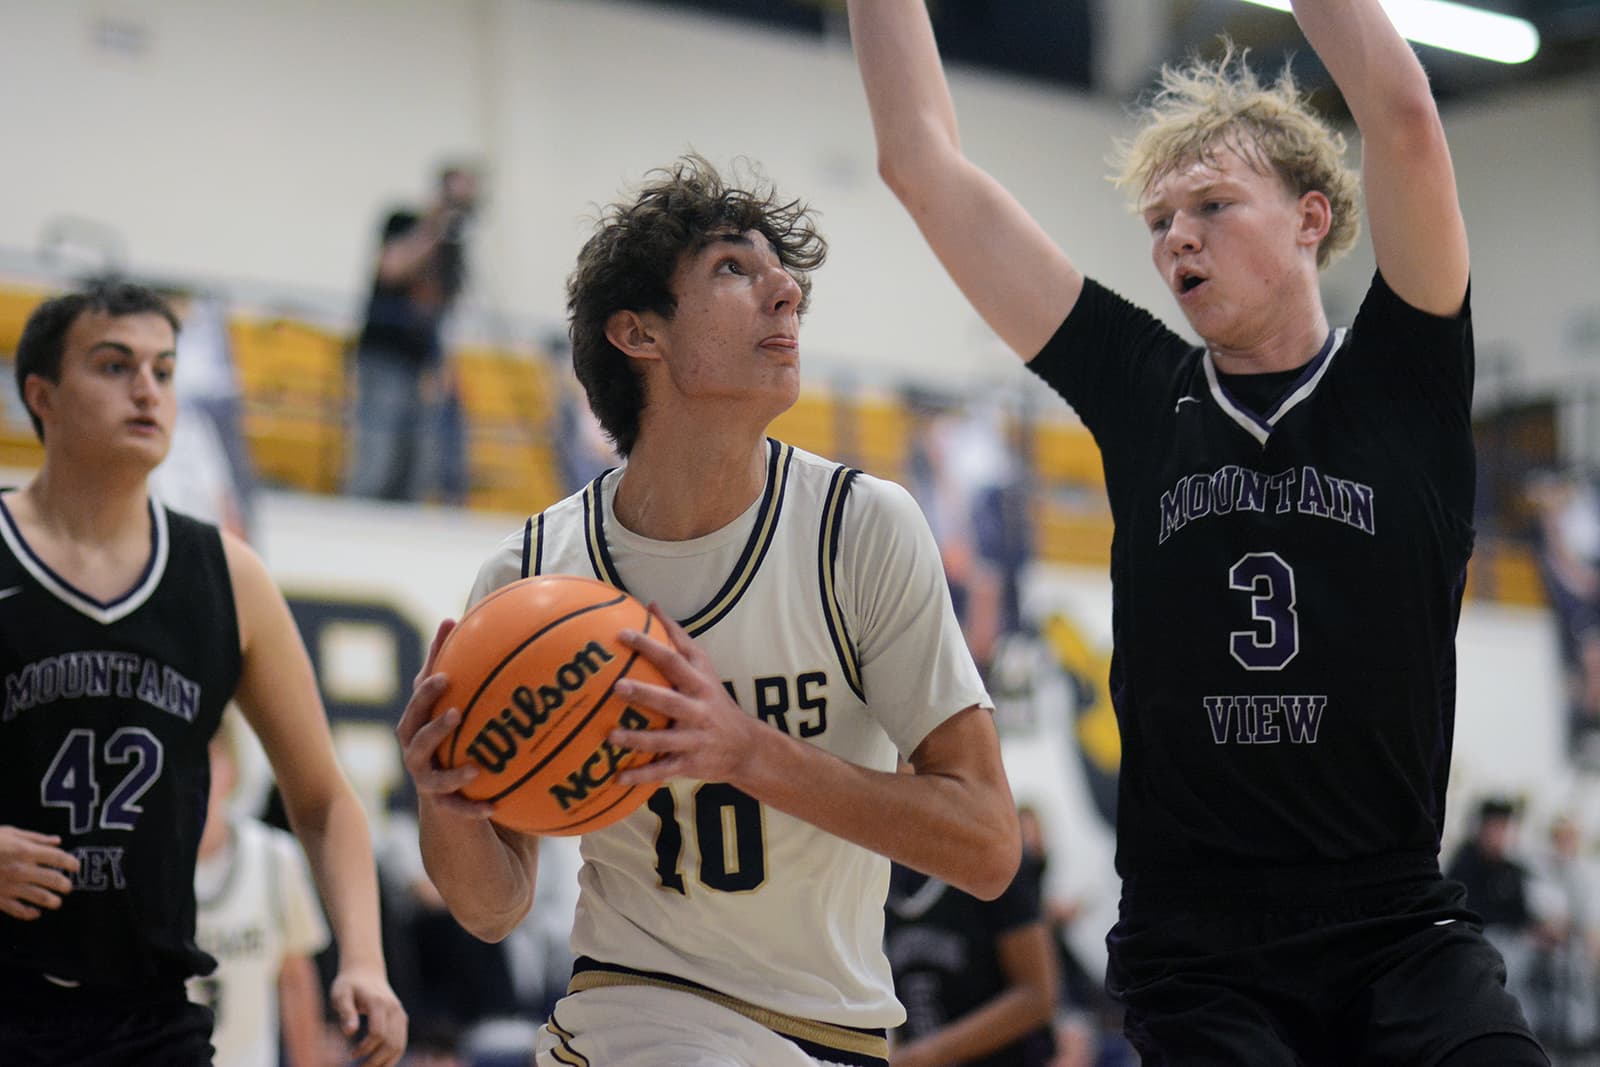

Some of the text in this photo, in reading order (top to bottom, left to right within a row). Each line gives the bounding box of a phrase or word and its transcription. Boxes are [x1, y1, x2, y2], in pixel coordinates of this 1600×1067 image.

[1158, 465, 1376, 546] MOUNTAIN
[1228, 551, 1300, 671] 3
[1, 650, 202, 724] MOUNTAIN
[465, 639, 615, 775] Wilson
[1203, 694, 1328, 745] VIEW
[40, 726, 164, 835] 42
[645, 782, 770, 896] 10
